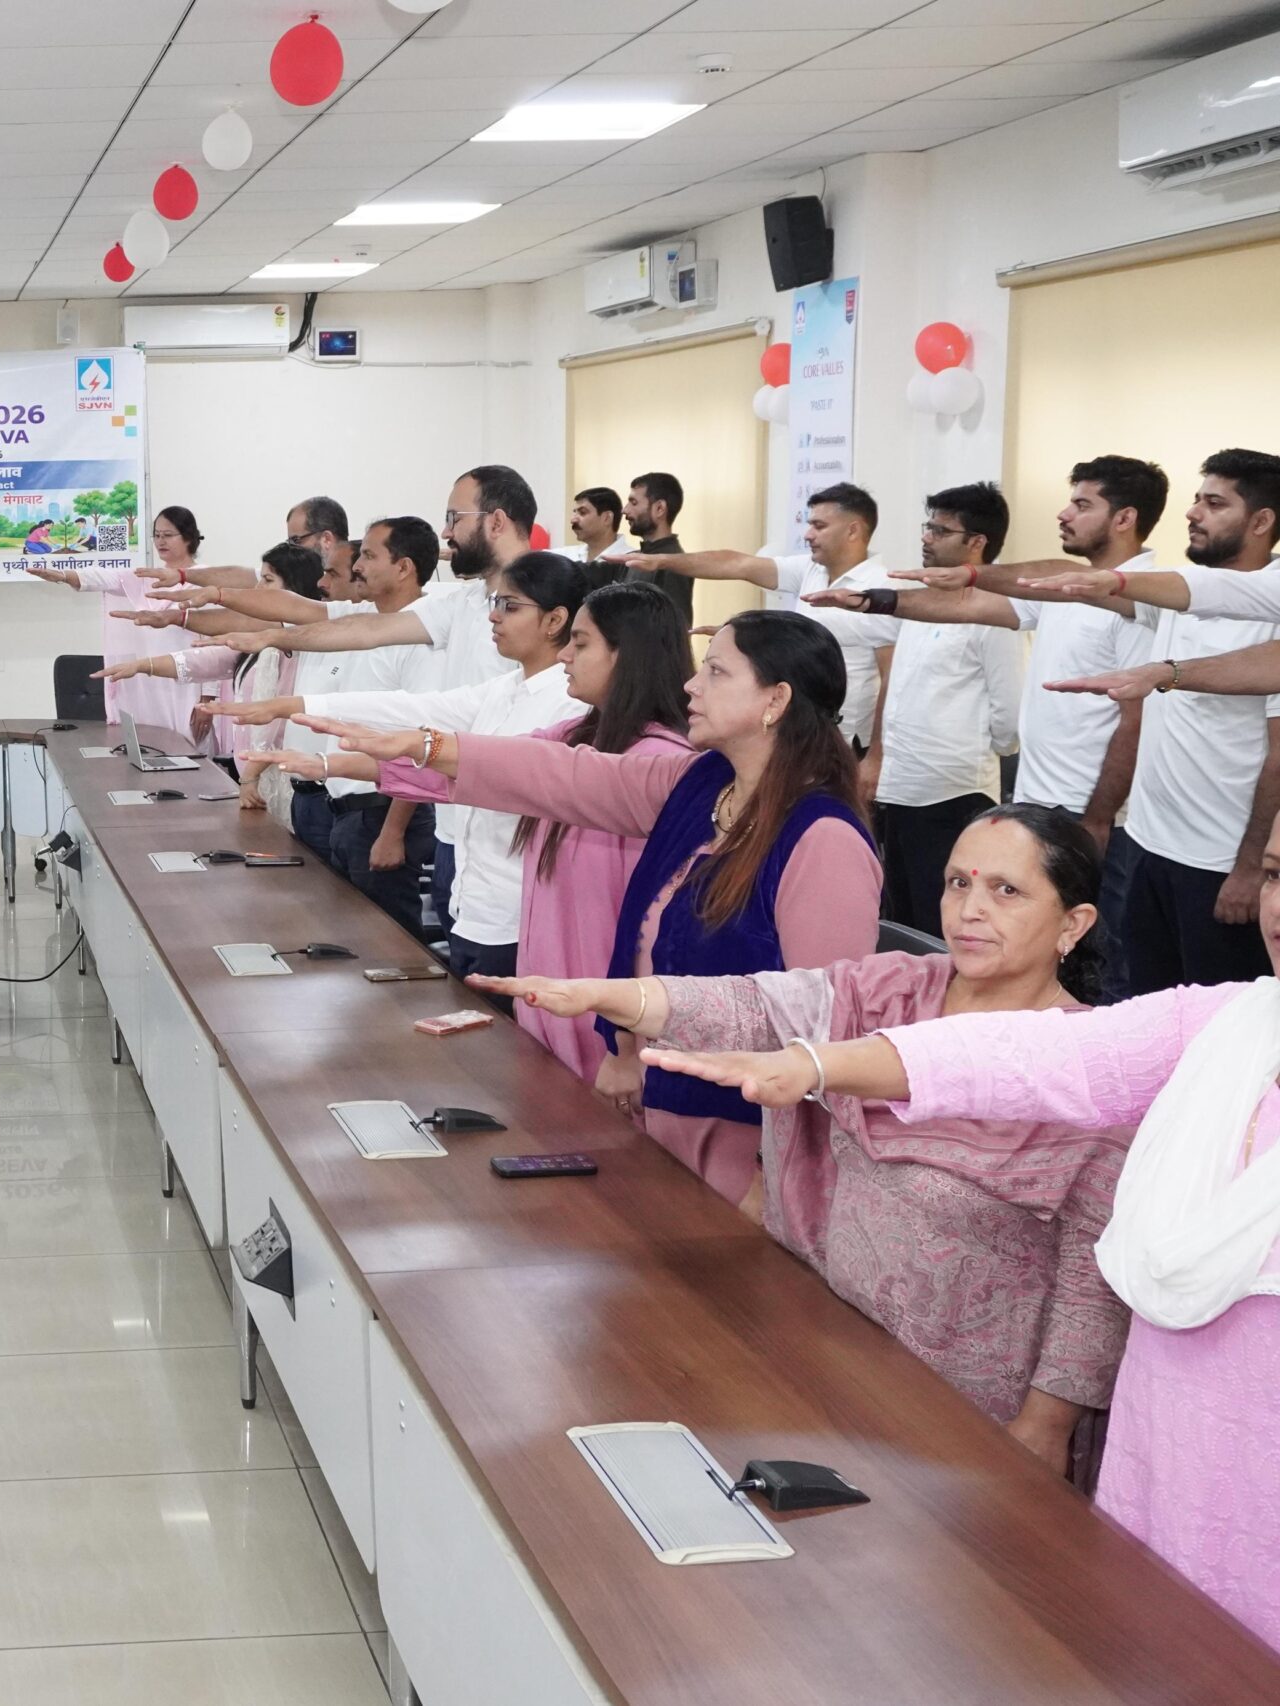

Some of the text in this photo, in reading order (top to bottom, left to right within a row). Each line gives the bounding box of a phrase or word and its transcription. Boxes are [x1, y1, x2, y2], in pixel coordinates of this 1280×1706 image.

[4, 493, 43, 504] मेगावाट
[33, 557, 47, 569] को
[51, 556, 95, 570] भागीदार
[98, 558, 131, 568] बनाना
